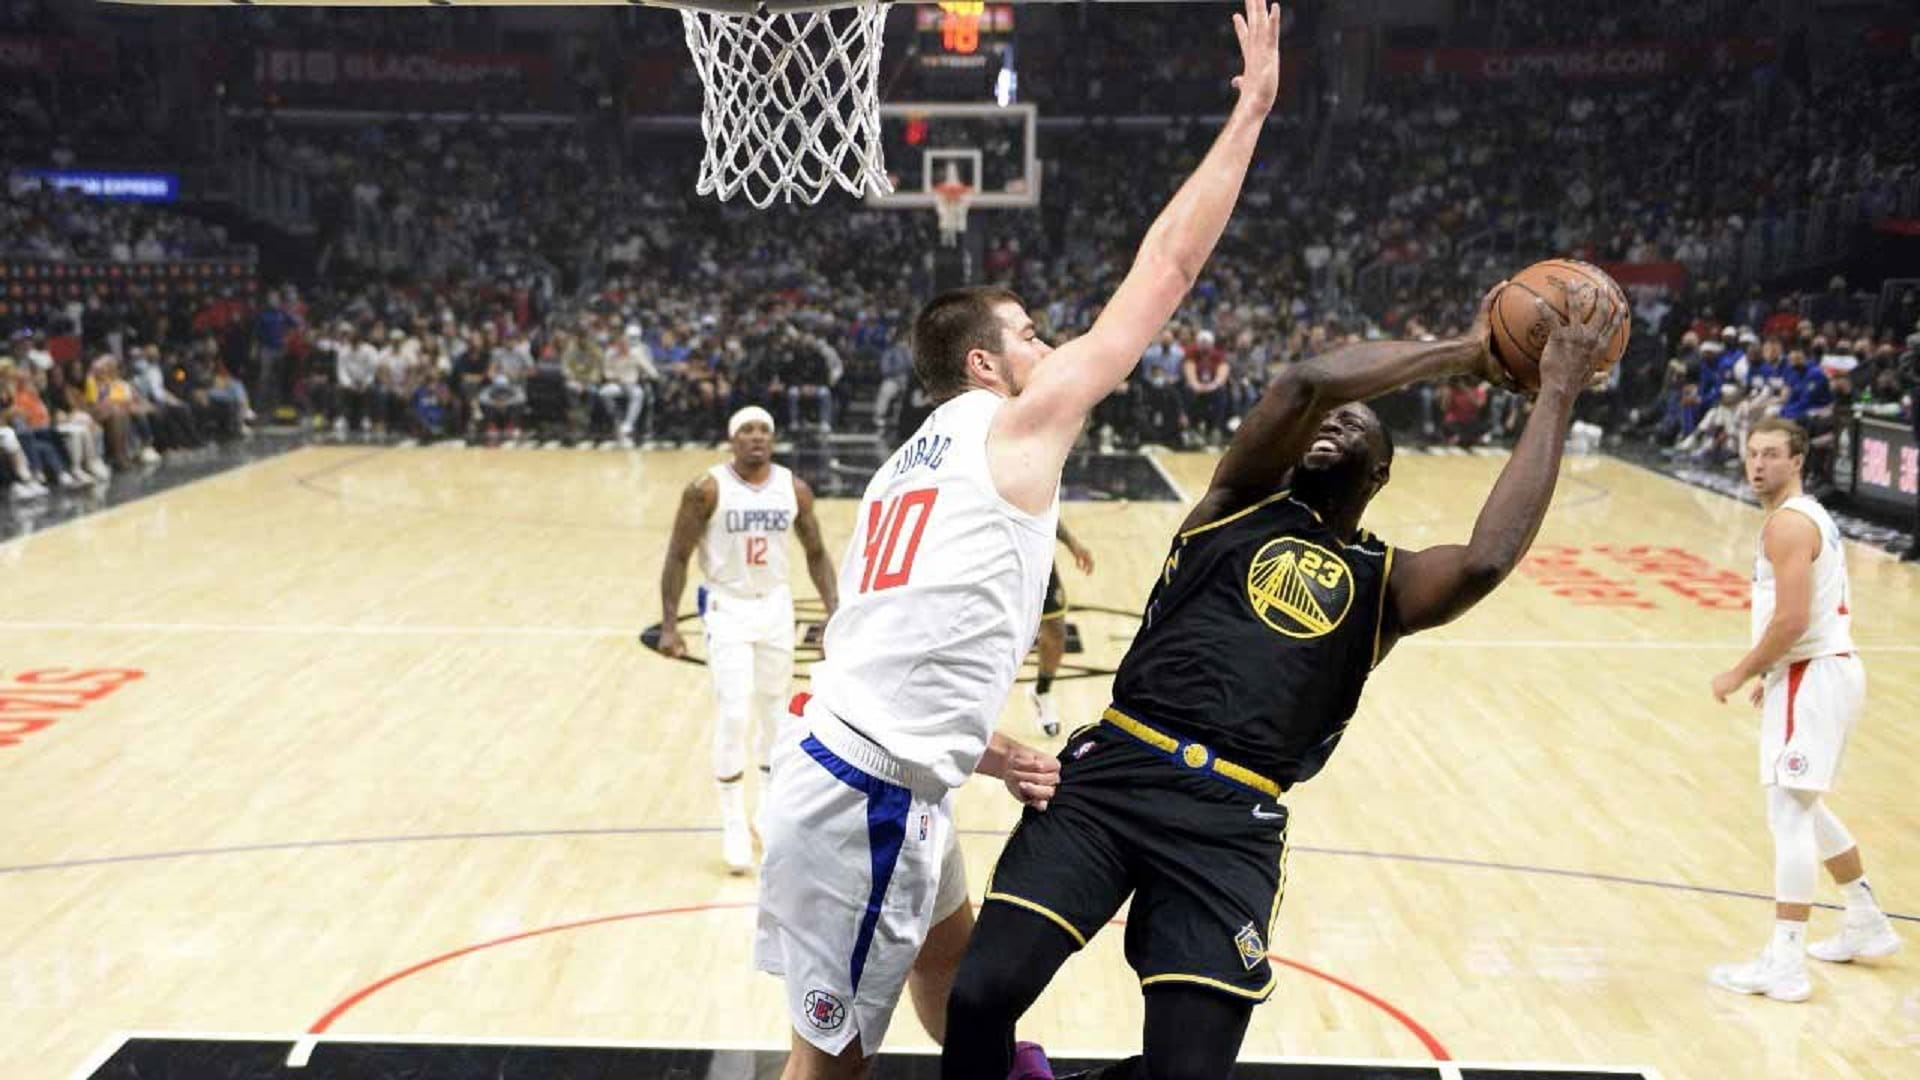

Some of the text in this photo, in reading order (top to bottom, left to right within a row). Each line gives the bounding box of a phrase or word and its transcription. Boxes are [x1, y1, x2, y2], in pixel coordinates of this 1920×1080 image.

[890, 434, 952, 479] UBAC
[726, 509, 790, 533] CLIPPERS
[746, 536, 768, 566] 12
[859, 487, 939, 595] 40
[1299, 550, 1344, 589] 23
